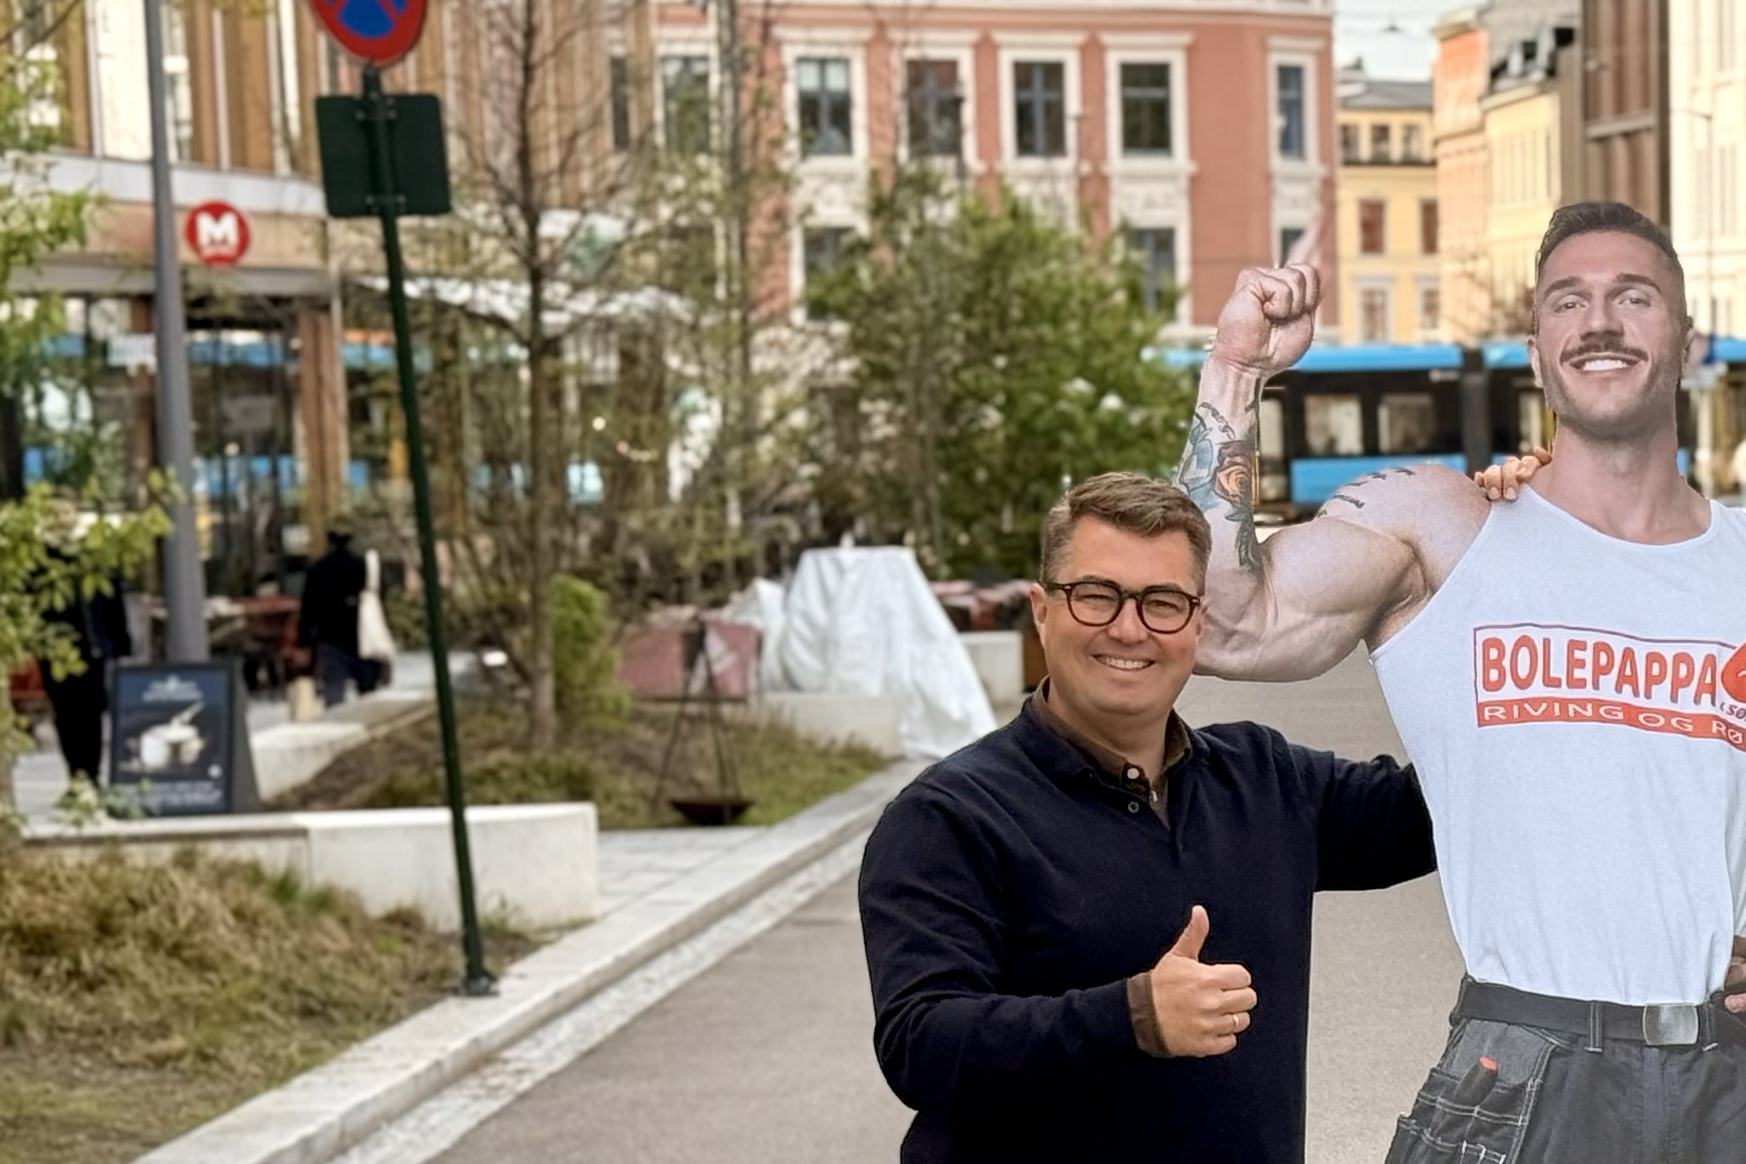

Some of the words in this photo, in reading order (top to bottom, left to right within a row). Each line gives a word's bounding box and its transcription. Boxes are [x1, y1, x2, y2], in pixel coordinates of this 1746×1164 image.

[197, 211, 238, 245] M
[1482, 635, 1717, 707] BOLEPAPPA
[1484, 702, 1624, 721] RIVING
[1638, 712, 1694, 732] OG
